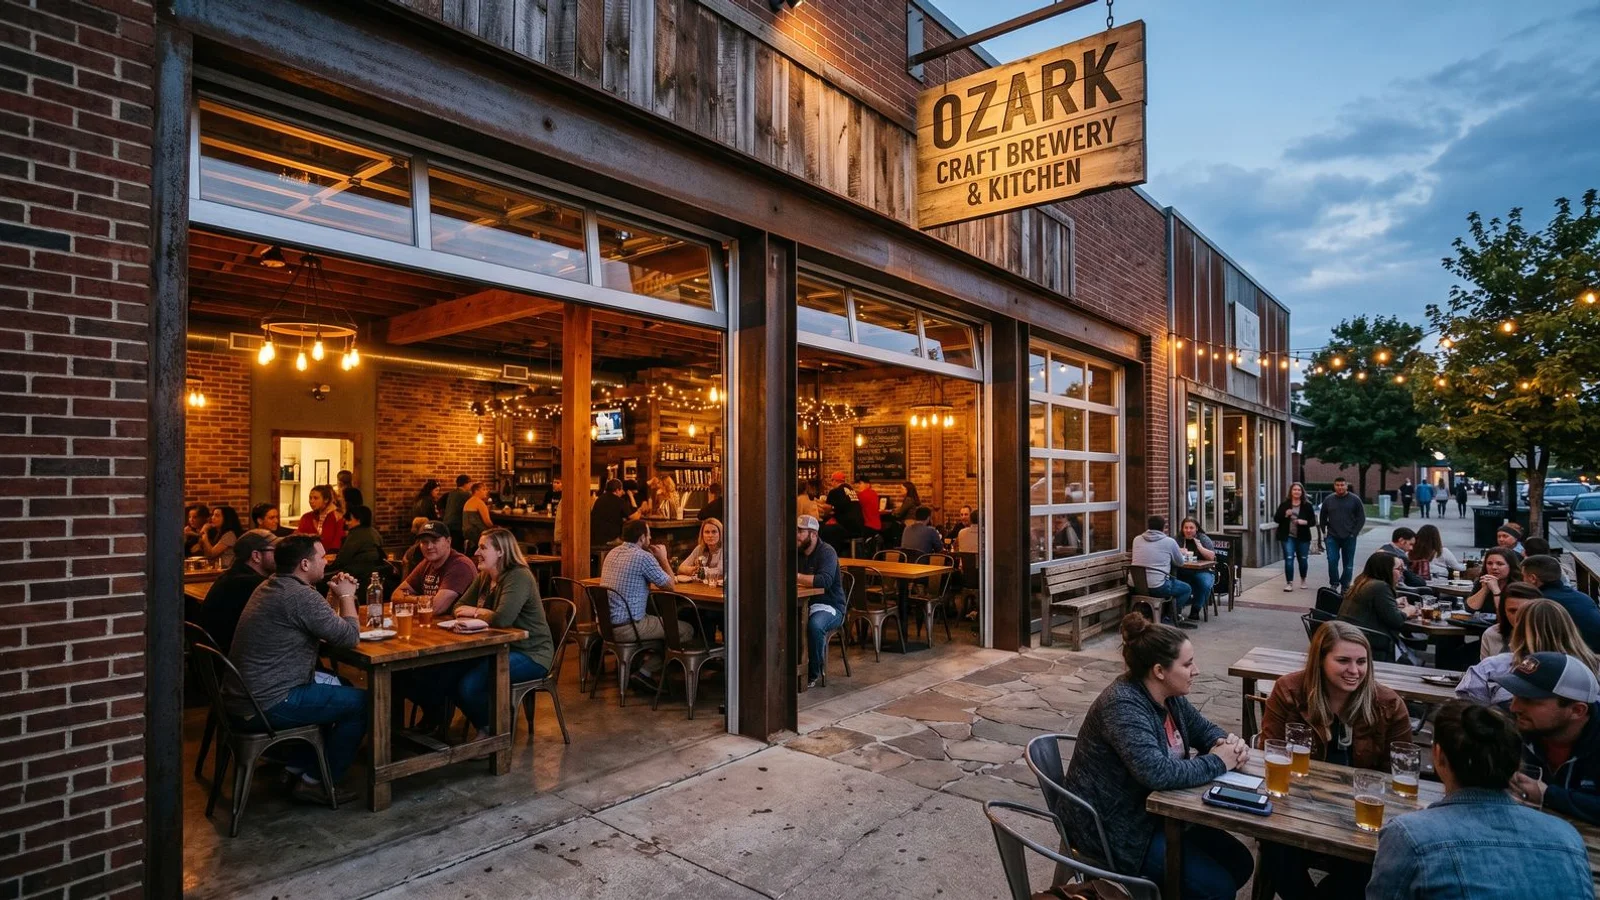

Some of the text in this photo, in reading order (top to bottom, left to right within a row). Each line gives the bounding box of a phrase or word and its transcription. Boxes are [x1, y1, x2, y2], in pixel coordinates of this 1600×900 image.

[933, 41, 1123, 150] OZARK
[937, 116, 1117, 184] CRAFT BREWERY
[967, 158, 1081, 206] & KITCHEN
